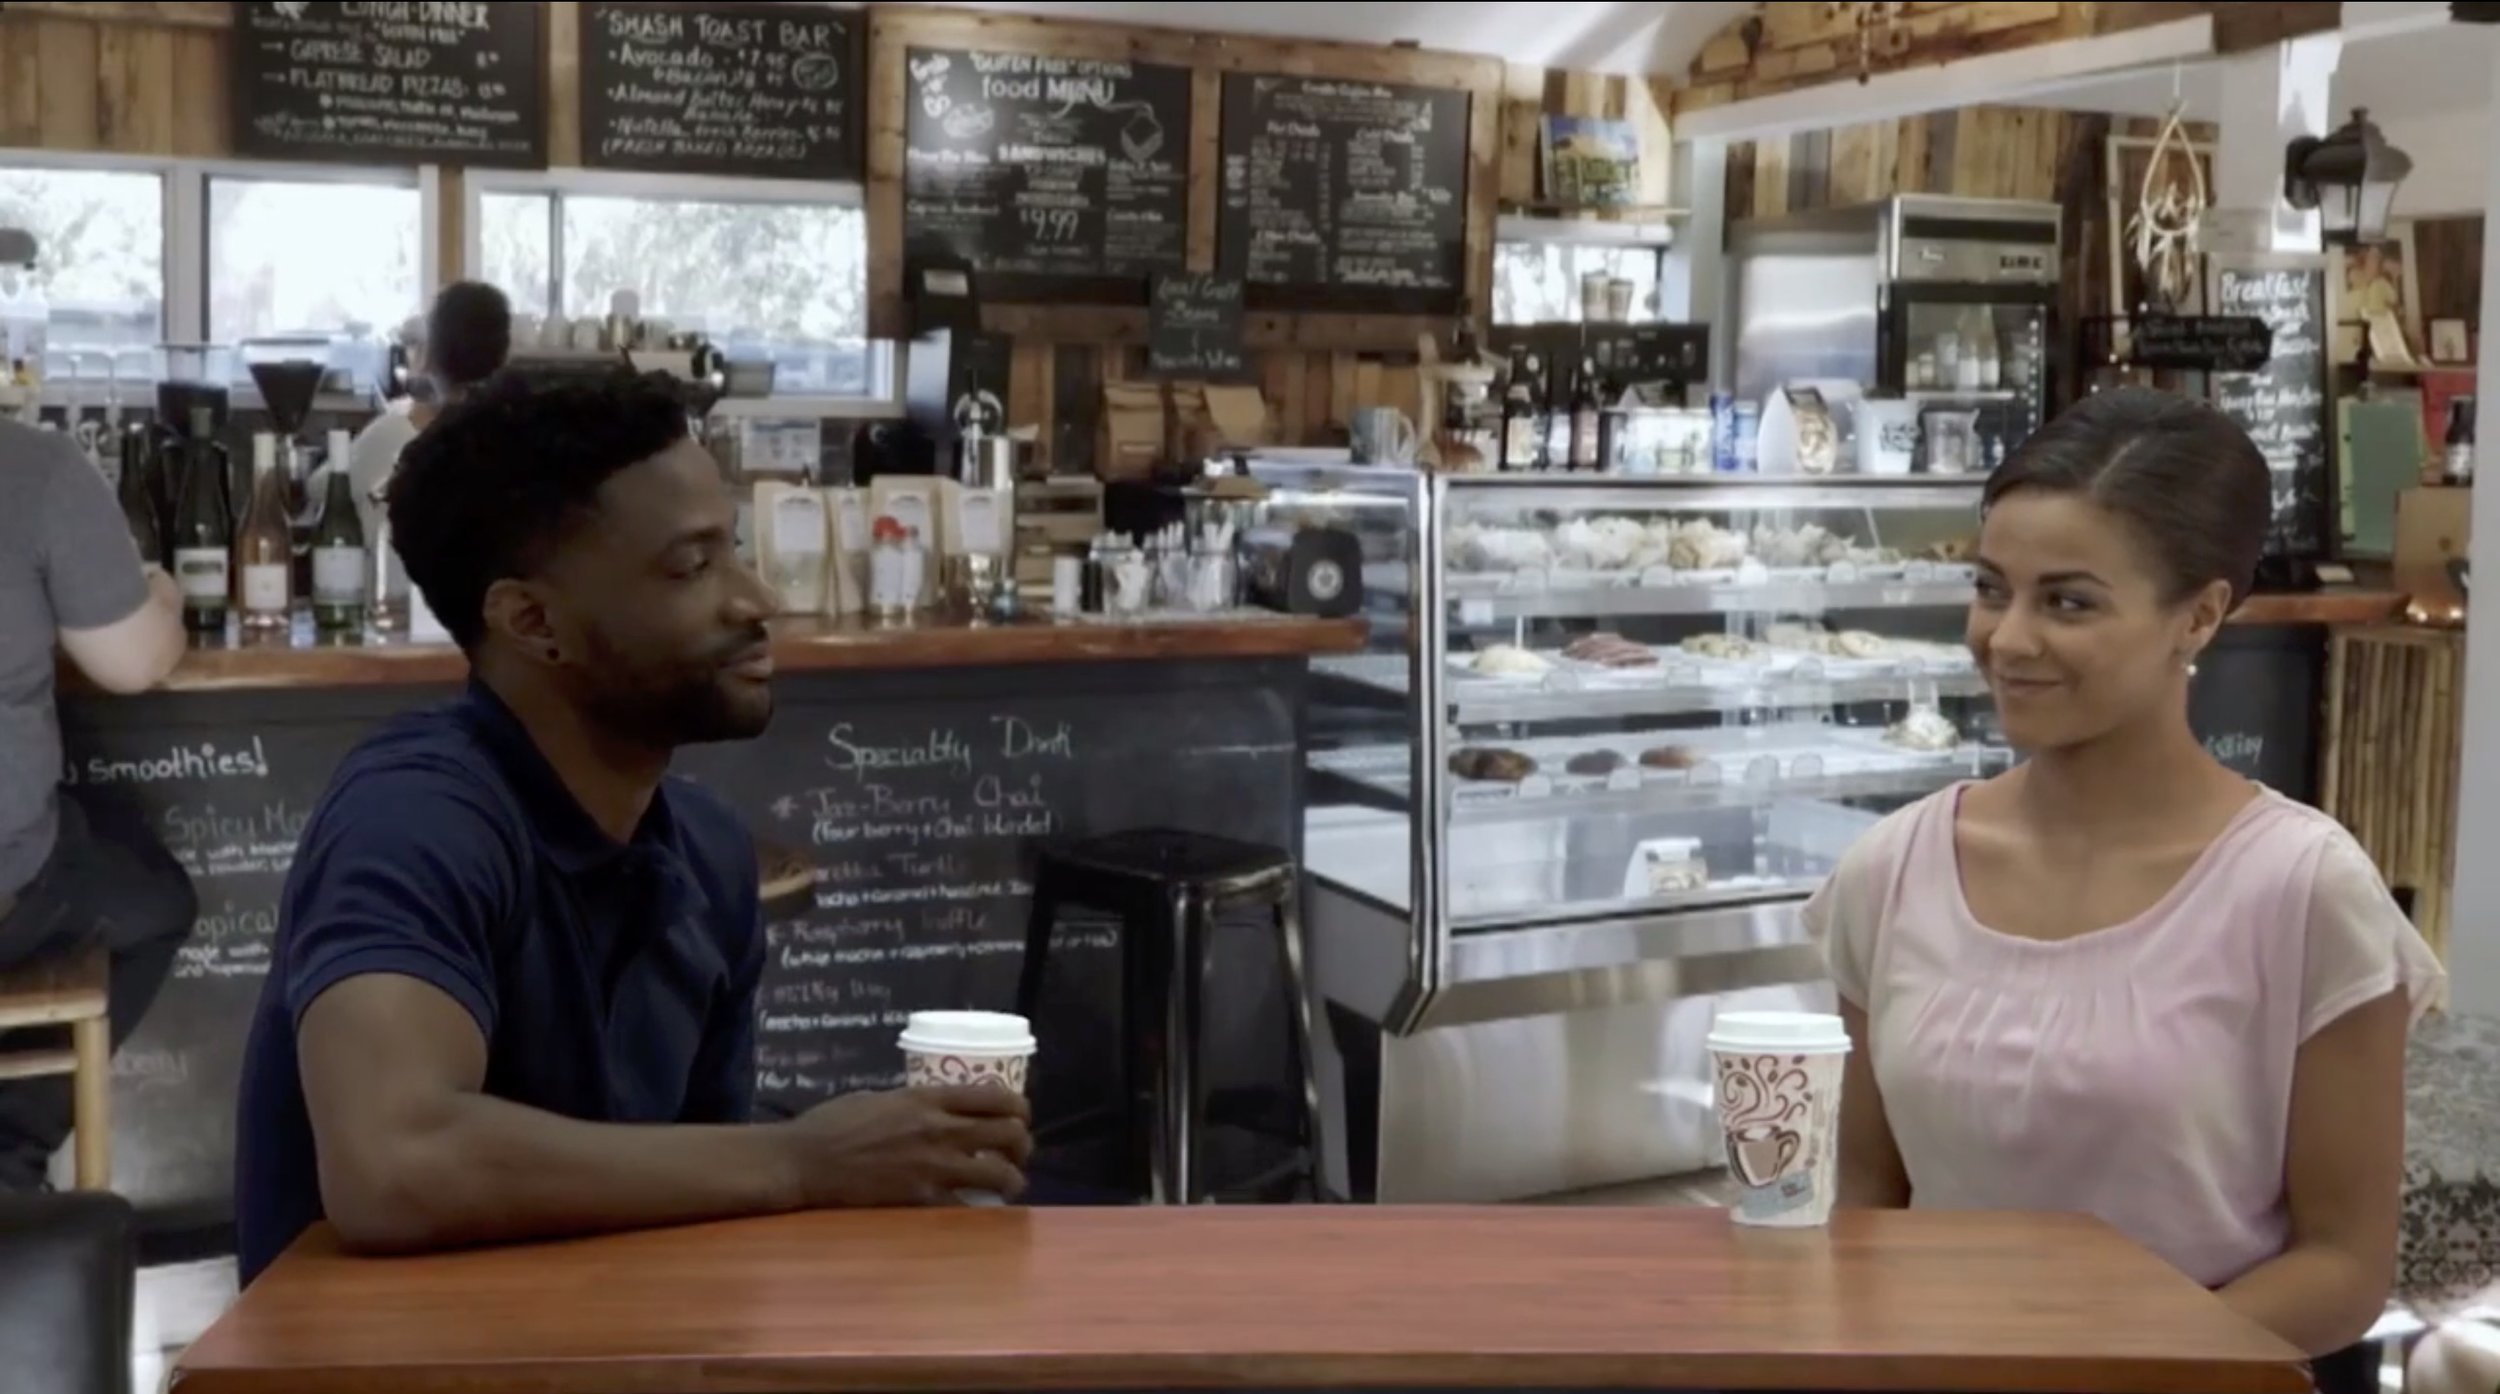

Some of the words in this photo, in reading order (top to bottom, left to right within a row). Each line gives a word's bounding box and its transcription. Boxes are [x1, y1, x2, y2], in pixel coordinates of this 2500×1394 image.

[694, 12, 767, 44] TOAST
[619, 41, 715, 69] Avocado
[195, 899, 280, 941] opical
